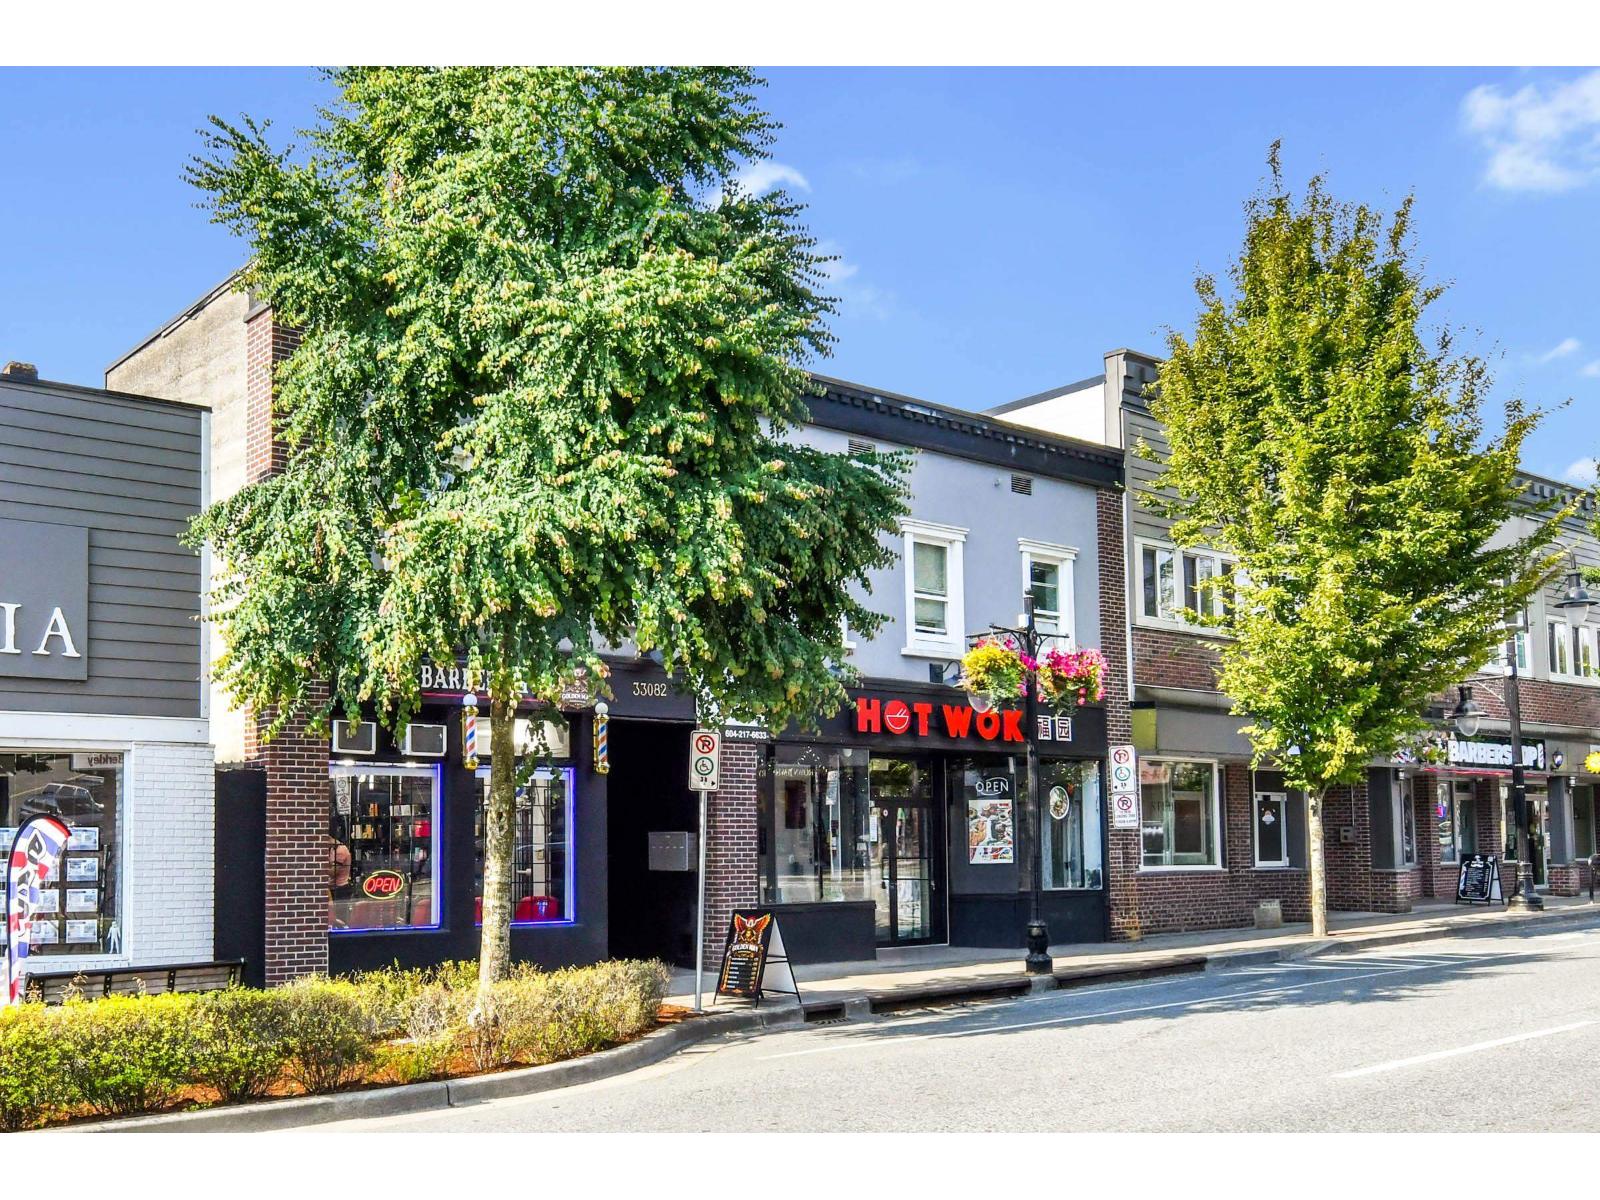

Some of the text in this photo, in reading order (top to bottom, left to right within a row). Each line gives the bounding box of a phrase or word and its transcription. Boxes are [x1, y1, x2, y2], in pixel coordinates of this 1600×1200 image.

[632, 681, 668, 697] 33082
[856, 697, 1025, 742] HOT WOK
[975, 781, 1009, 792] OPEN
[365, 877, 400, 892] OPEN
